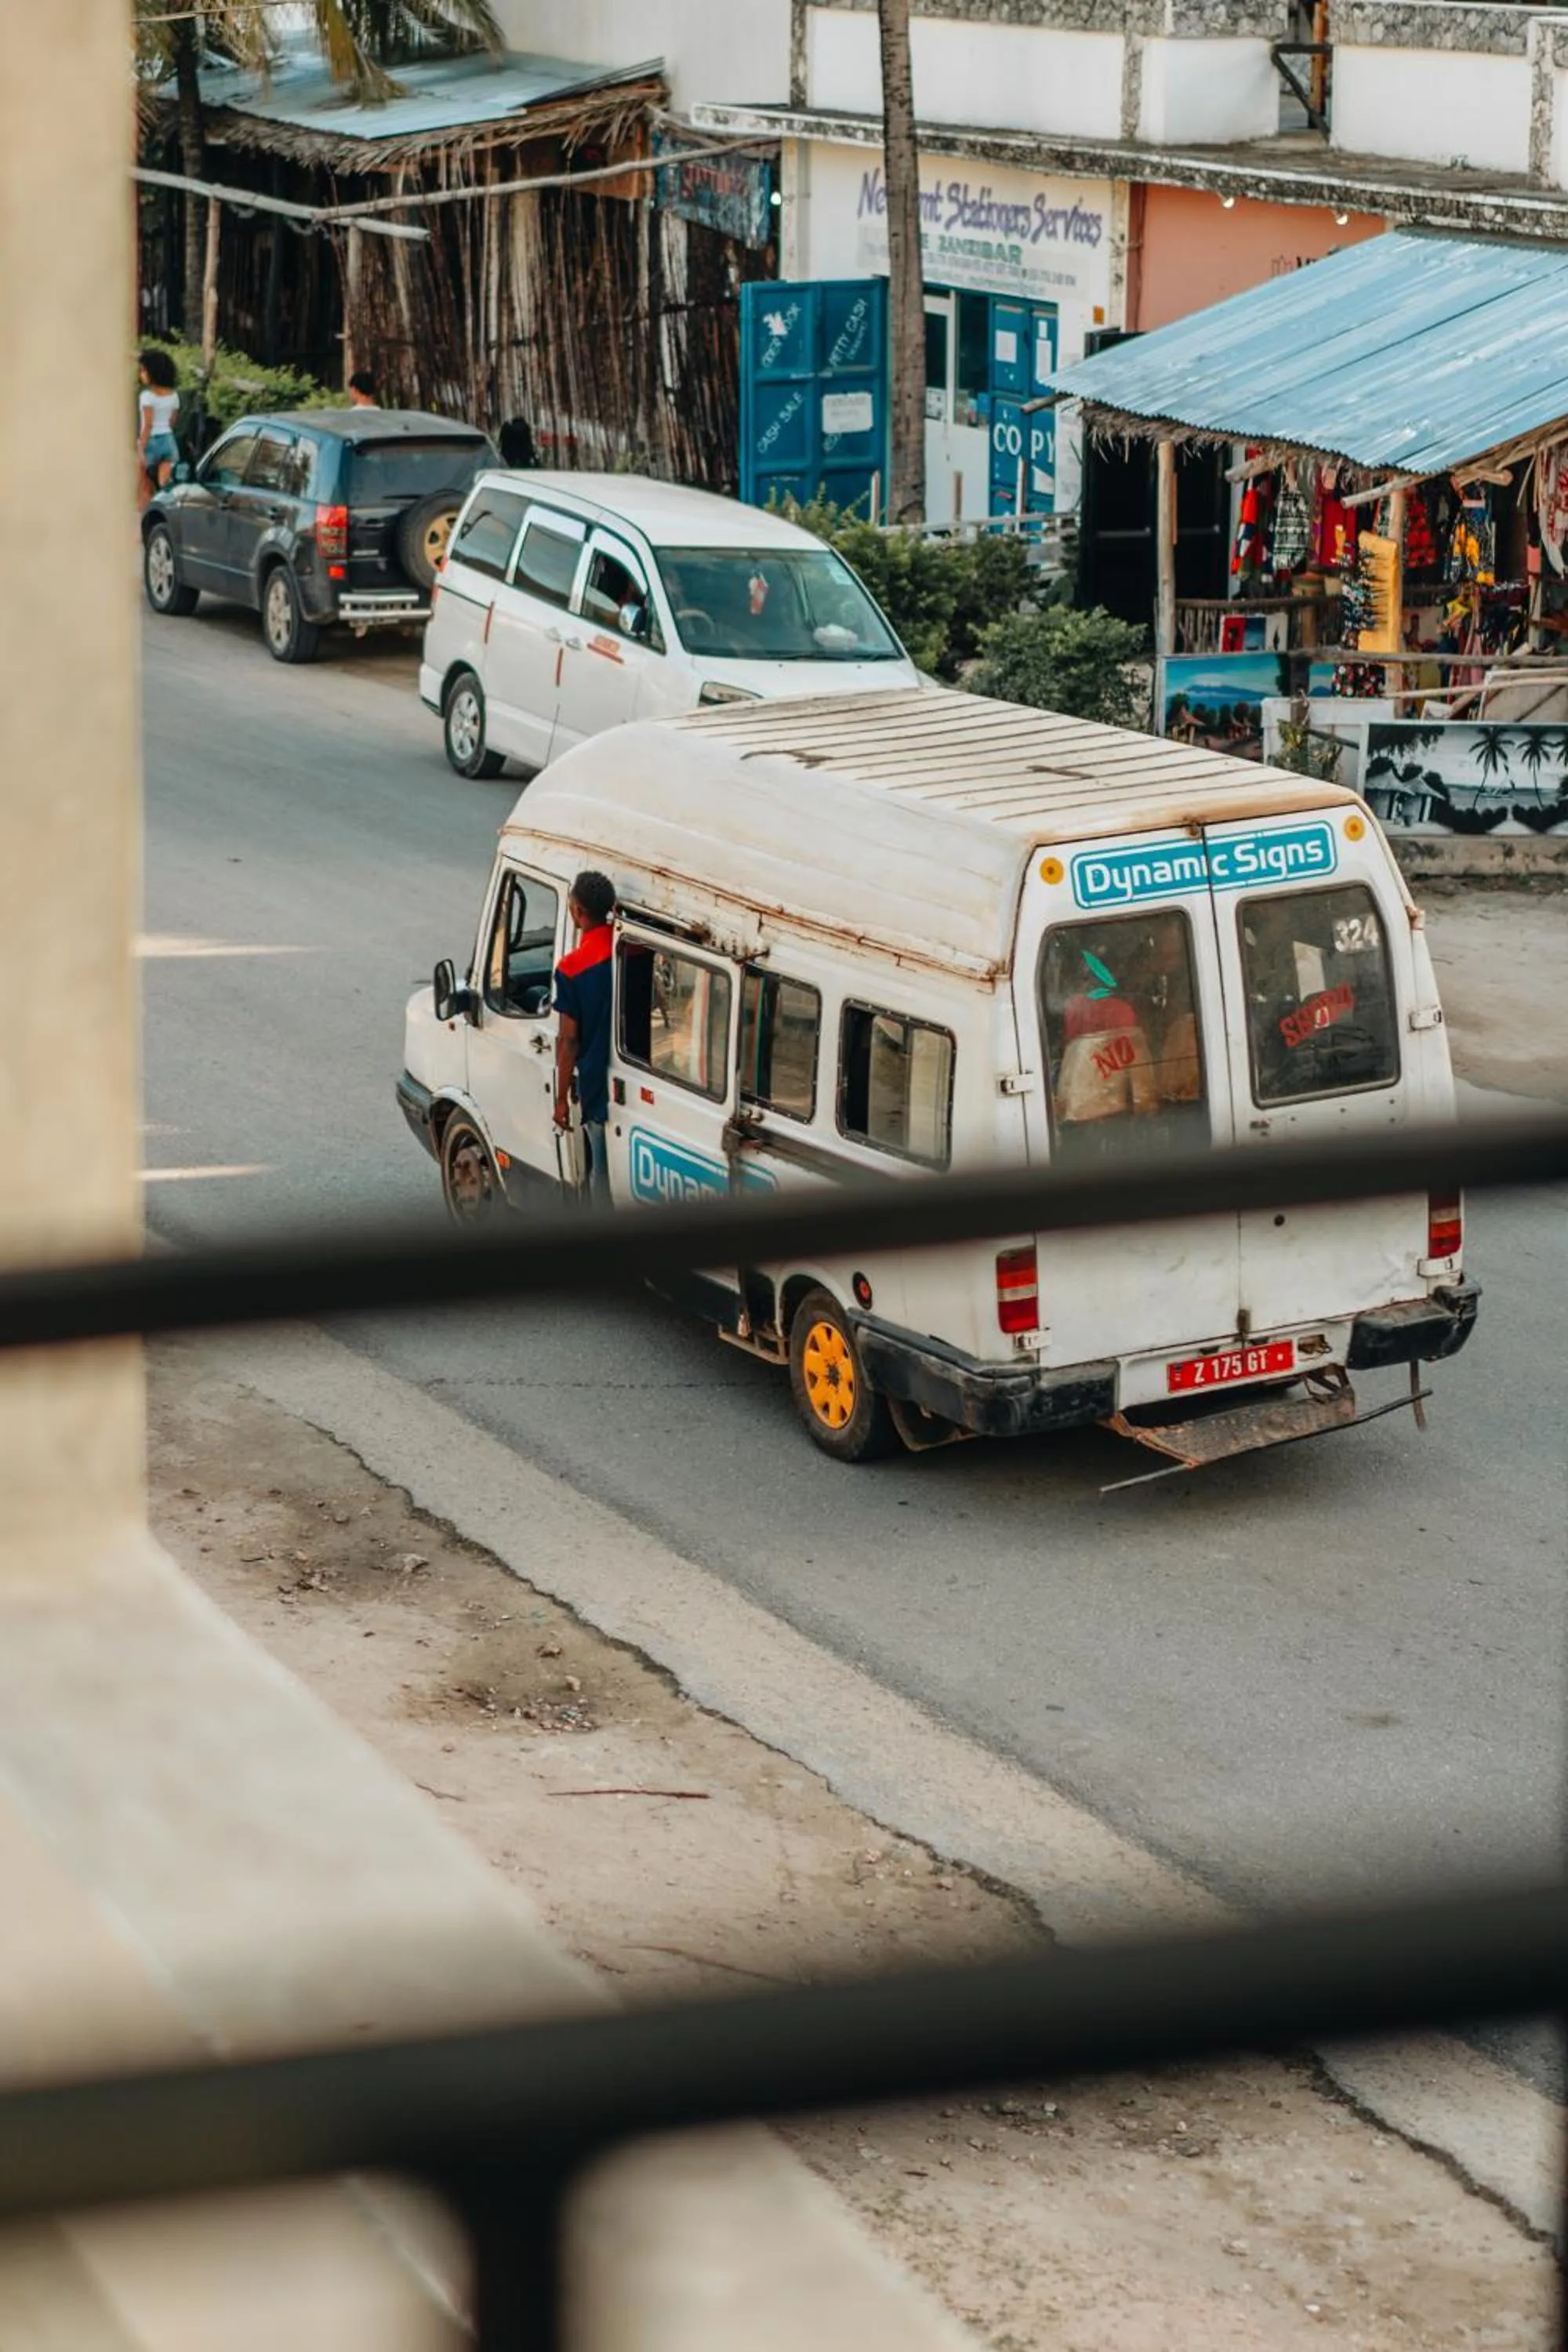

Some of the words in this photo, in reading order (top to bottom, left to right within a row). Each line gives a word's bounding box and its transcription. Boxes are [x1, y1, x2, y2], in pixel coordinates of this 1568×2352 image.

[857, 167, 887, 219] Ne
[1085, 854, 1230, 901] Dynamic
[1233, 840, 1323, 877] Signs
[1334, 913, 1378, 953] 324
[1091, 1036, 1135, 1079] NO
[1194, 1362, 1205, 1384] Z
[1212, 1354, 1243, 1380] 175
[1248, 1349, 1268, 1372] GT
